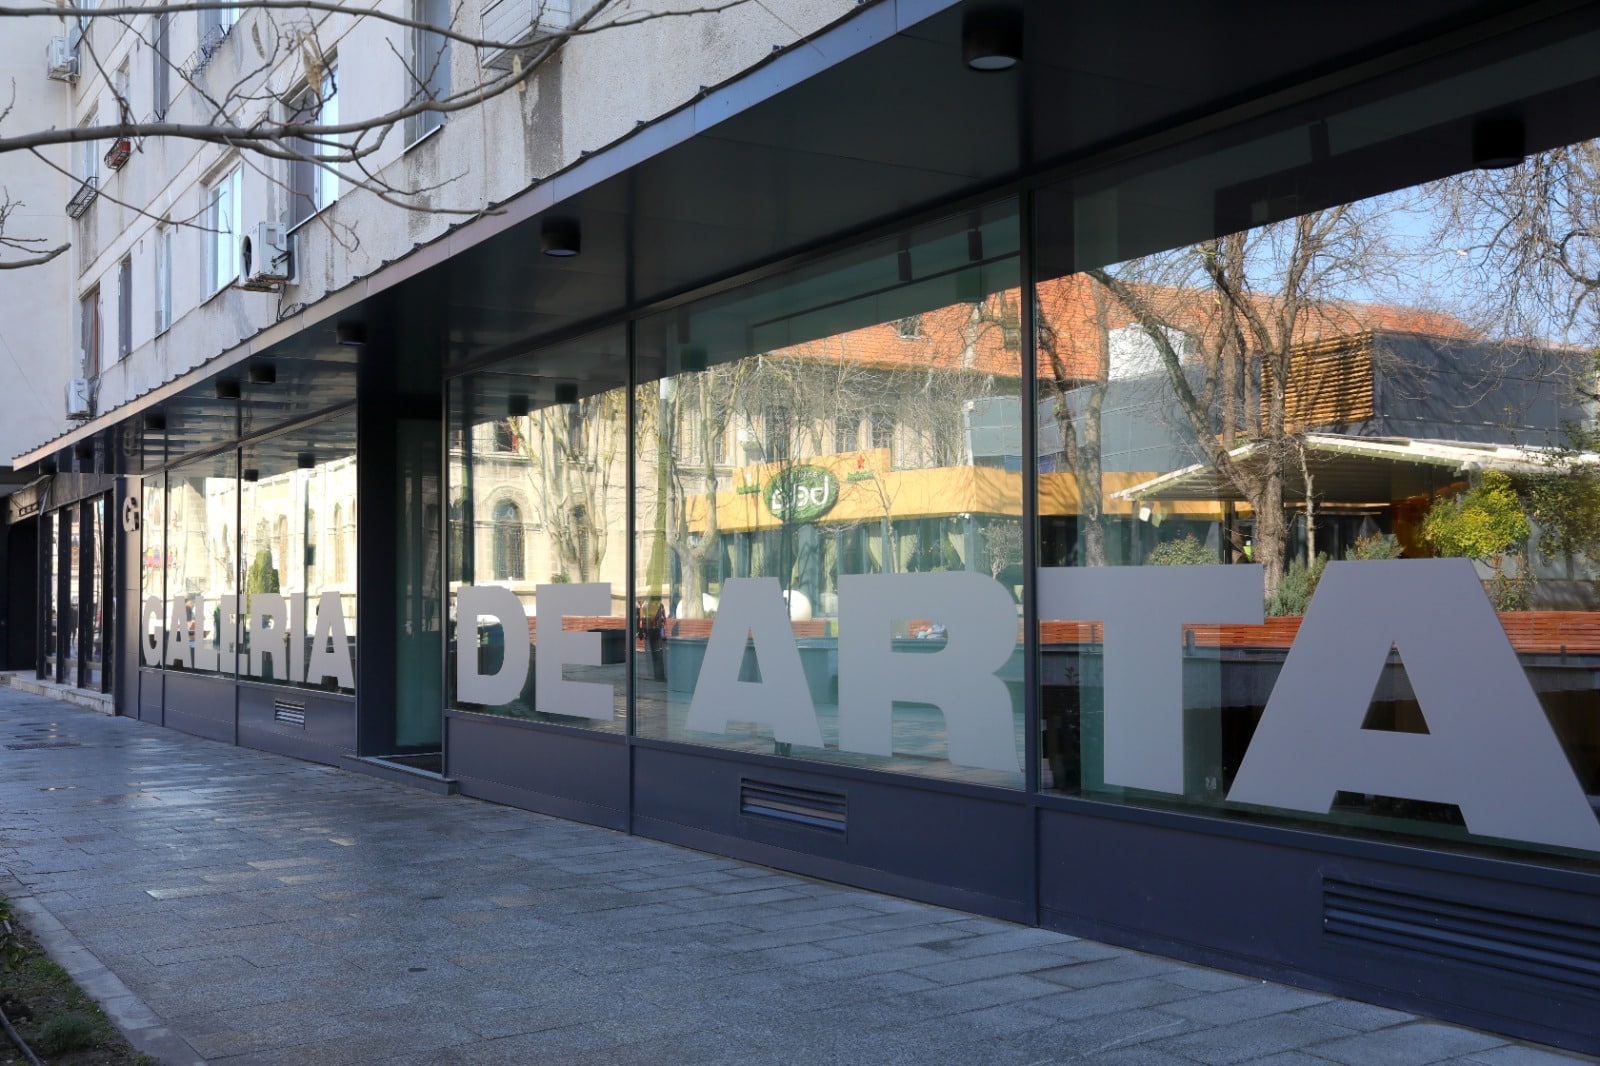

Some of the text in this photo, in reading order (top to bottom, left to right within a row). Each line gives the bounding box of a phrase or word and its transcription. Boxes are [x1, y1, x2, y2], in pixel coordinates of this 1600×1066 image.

[142, 558, 1600, 852] GALERIA DE ARTA
